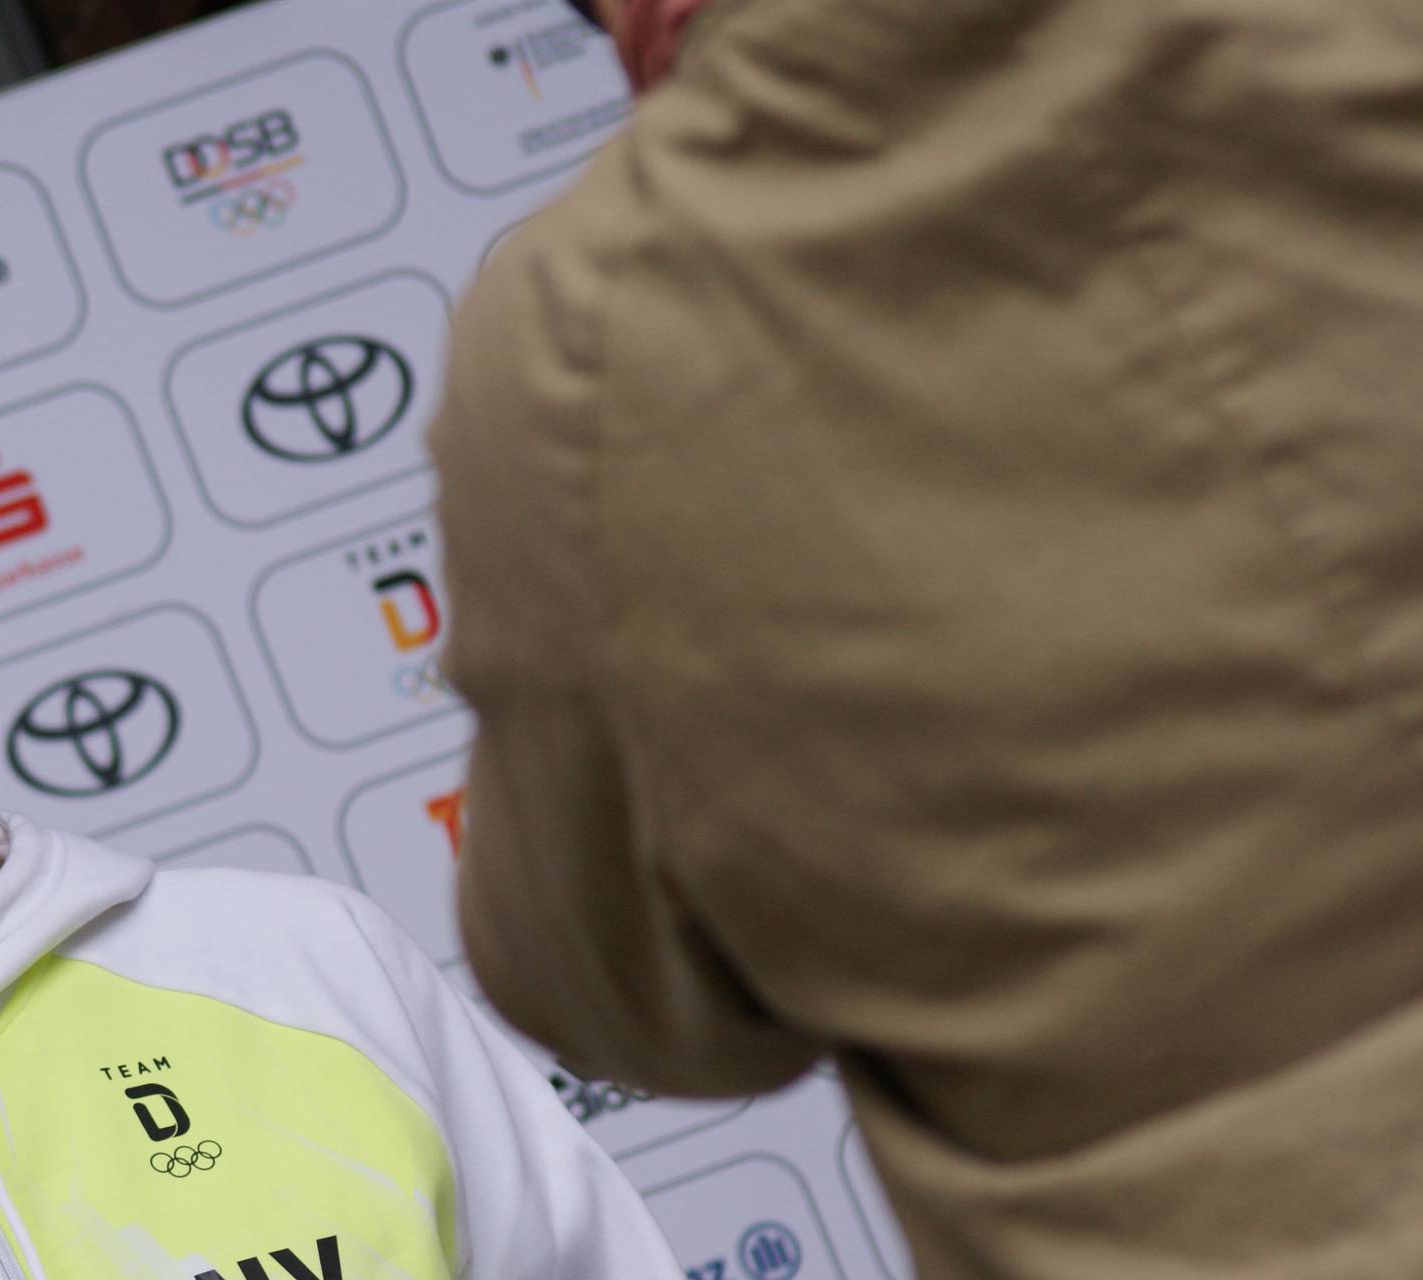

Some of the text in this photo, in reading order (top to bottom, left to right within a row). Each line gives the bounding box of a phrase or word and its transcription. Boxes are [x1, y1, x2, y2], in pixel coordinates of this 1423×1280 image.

[161, 109, 299, 189] DOSB
[346, 530, 427, 570] TEAM
[99, 1056, 172, 1081] TEAM
